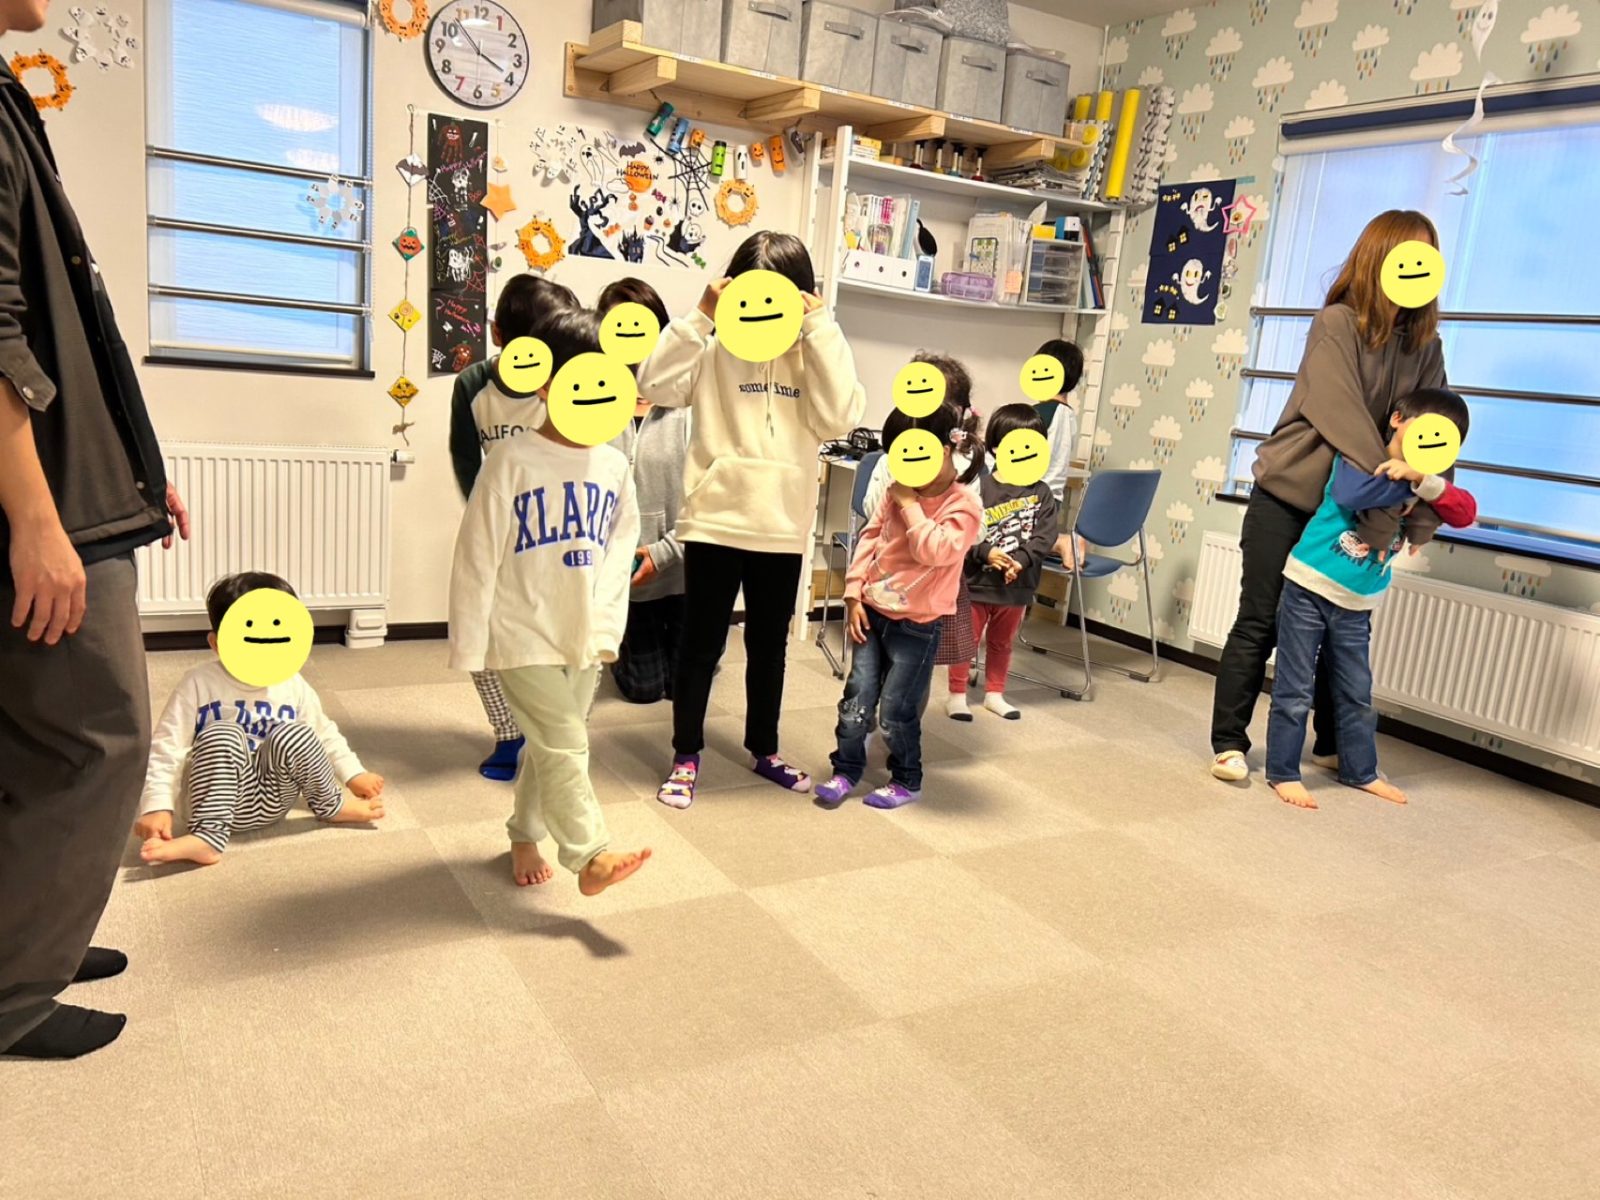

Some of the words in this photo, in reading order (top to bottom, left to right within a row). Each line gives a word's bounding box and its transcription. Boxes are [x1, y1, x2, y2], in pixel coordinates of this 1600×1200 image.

[474, 5, 489, 20] 12
[441, 21, 458, 38] 10
[496, 15, 503, 31] 1
[435, 38, 445, 53] 9
[507, 33, 517, 48] 2
[441, 59, 451, 74] 8
[513, 54, 522, 68] 3
[455, 76, 465, 91] 7
[505, 72, 514, 86] 4
[473, 85, 482, 99] 6
[491, 84, 501, 98] 5
[738, 381, 801, 399] someime
[480, 424, 527, 444] ALIFO
